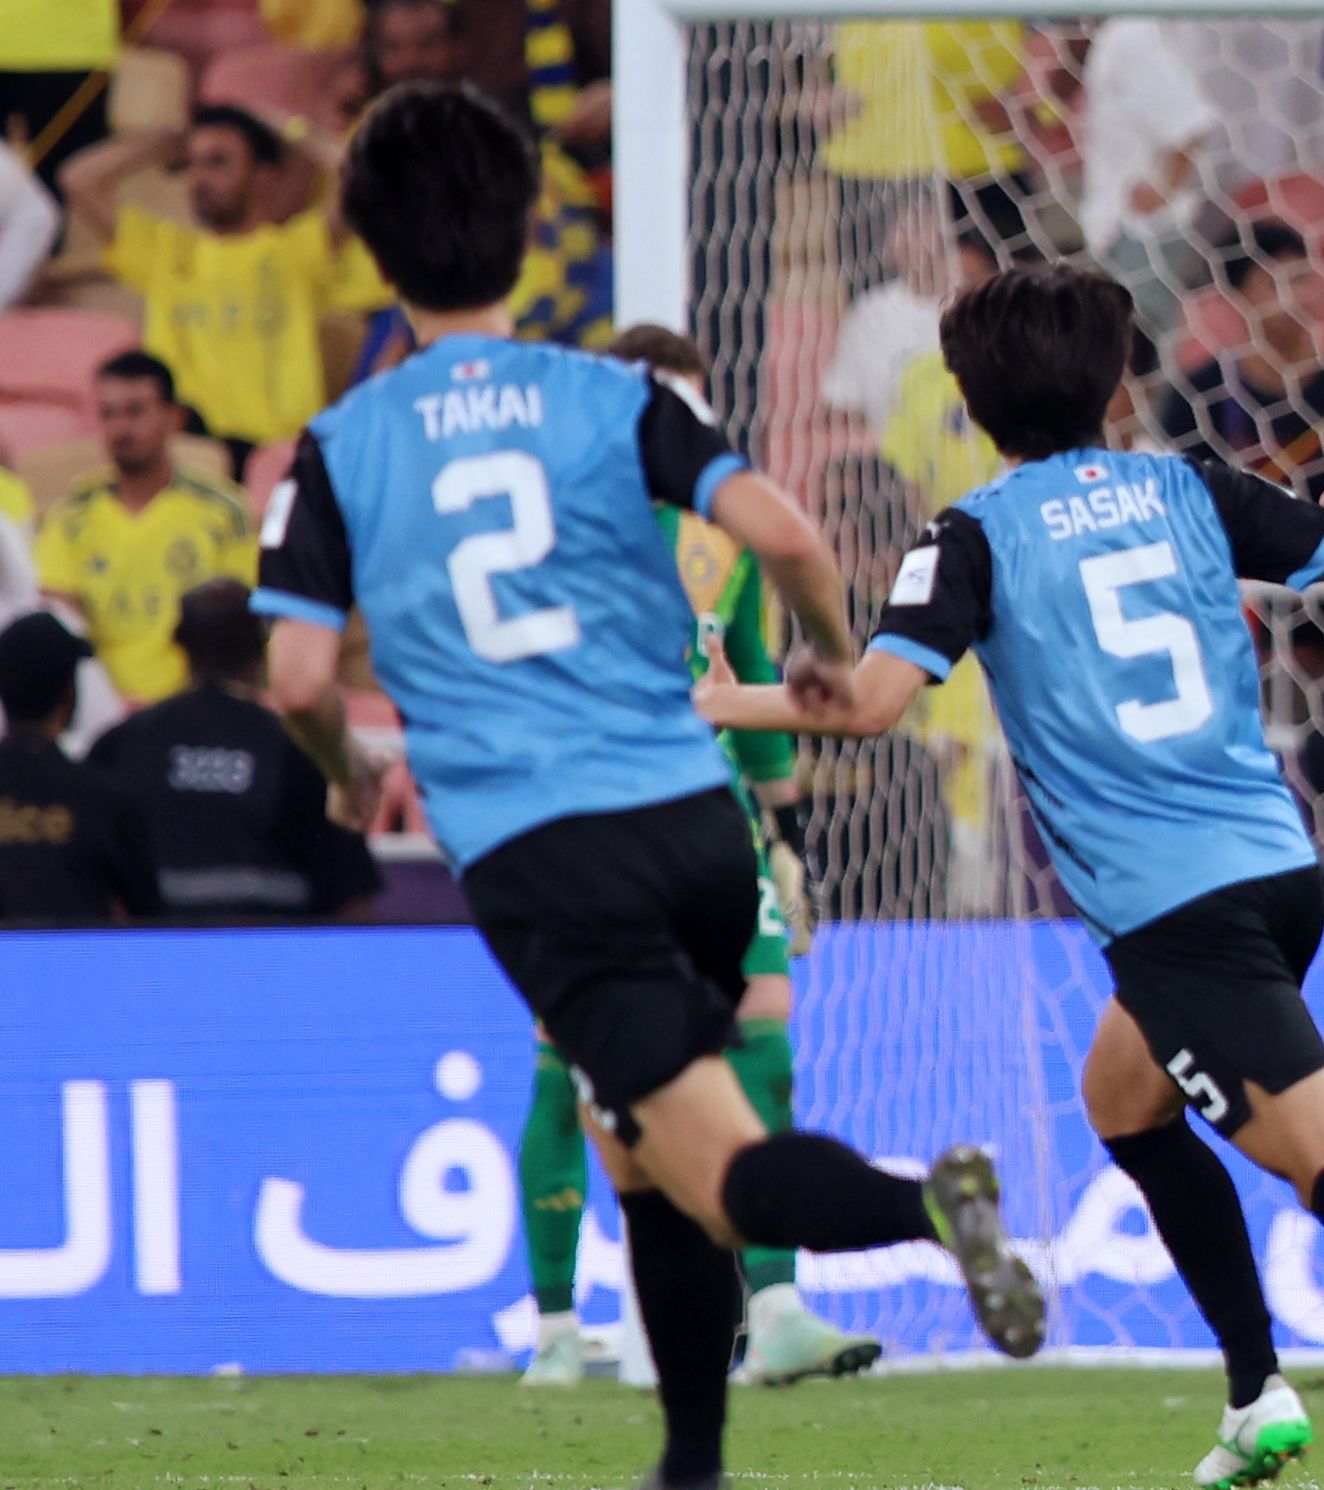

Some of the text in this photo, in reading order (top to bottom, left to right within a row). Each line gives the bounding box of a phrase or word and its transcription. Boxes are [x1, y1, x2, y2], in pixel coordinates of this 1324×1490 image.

[413, 383, 544, 441] TAKAI
[432, 449, 583, 664] 2
[1079, 541, 1214, 743] 5
[1165, 1048, 1229, 1122] 5
